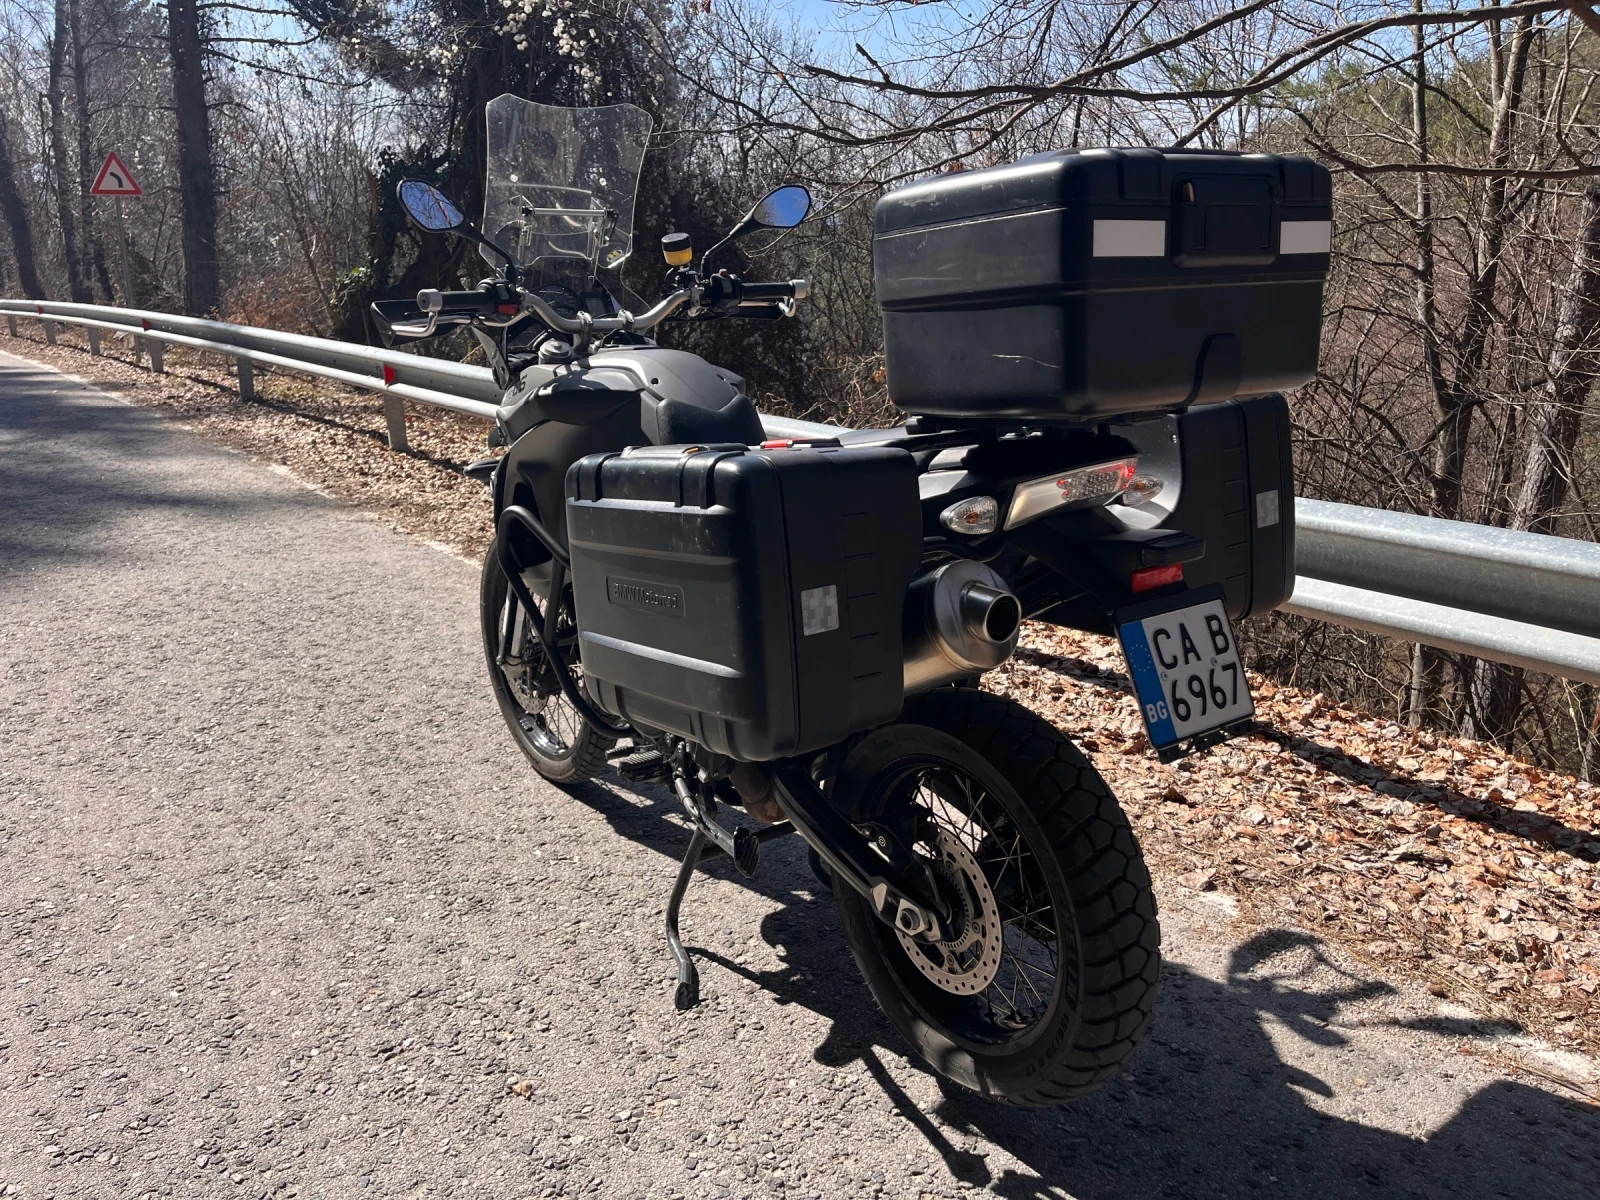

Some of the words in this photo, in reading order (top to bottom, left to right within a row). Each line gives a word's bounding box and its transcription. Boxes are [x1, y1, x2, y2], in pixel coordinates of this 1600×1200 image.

[613, 582, 635, 601] BMW
[636, 586, 679, 610] Motorrad
[1153, 621, 1202, 670] CA
[1204, 614, 1230, 656] B
[1146, 700, 1168, 724] BG
[1171, 662, 1238, 722] 6967
